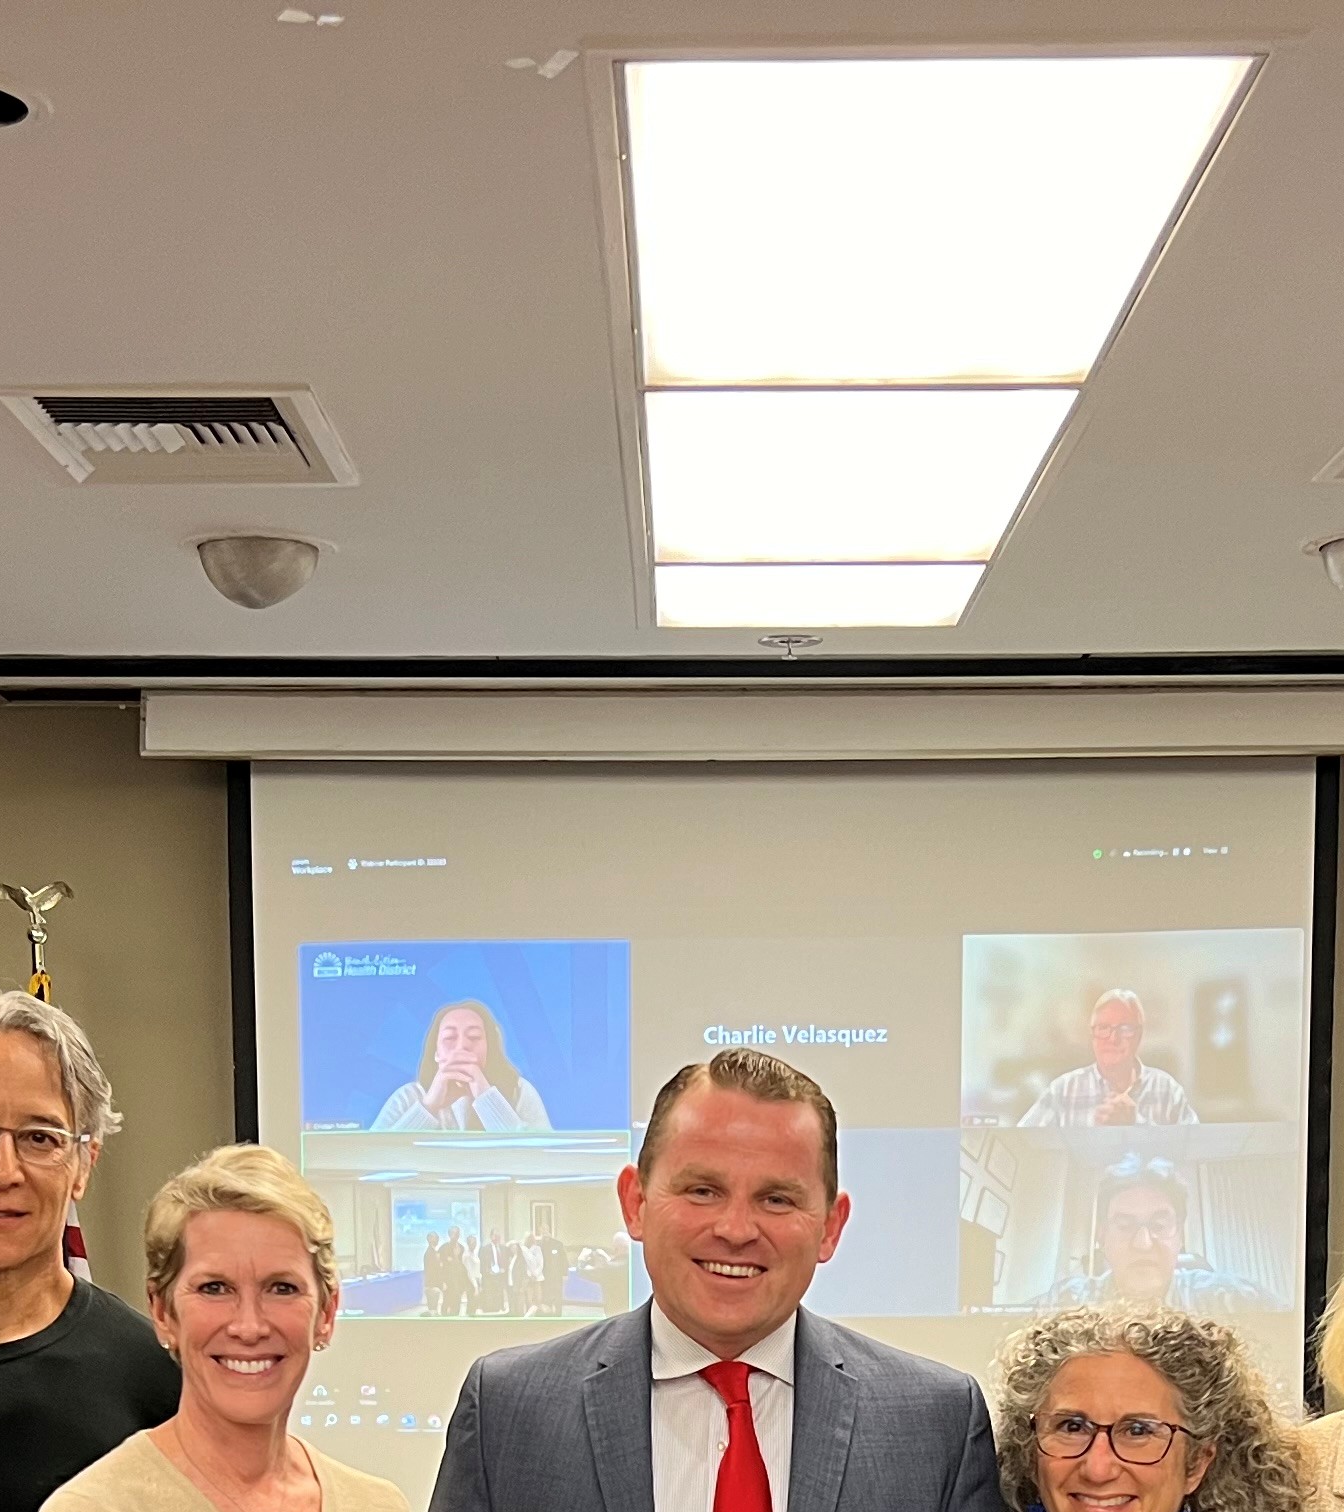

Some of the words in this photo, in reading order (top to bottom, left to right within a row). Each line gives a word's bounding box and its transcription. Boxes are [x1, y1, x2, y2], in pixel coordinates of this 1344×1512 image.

[379, 963, 416, 976] District
[703, 1025, 777, 1045] Charlie
[782, 1024, 888, 1048] Velasquez
